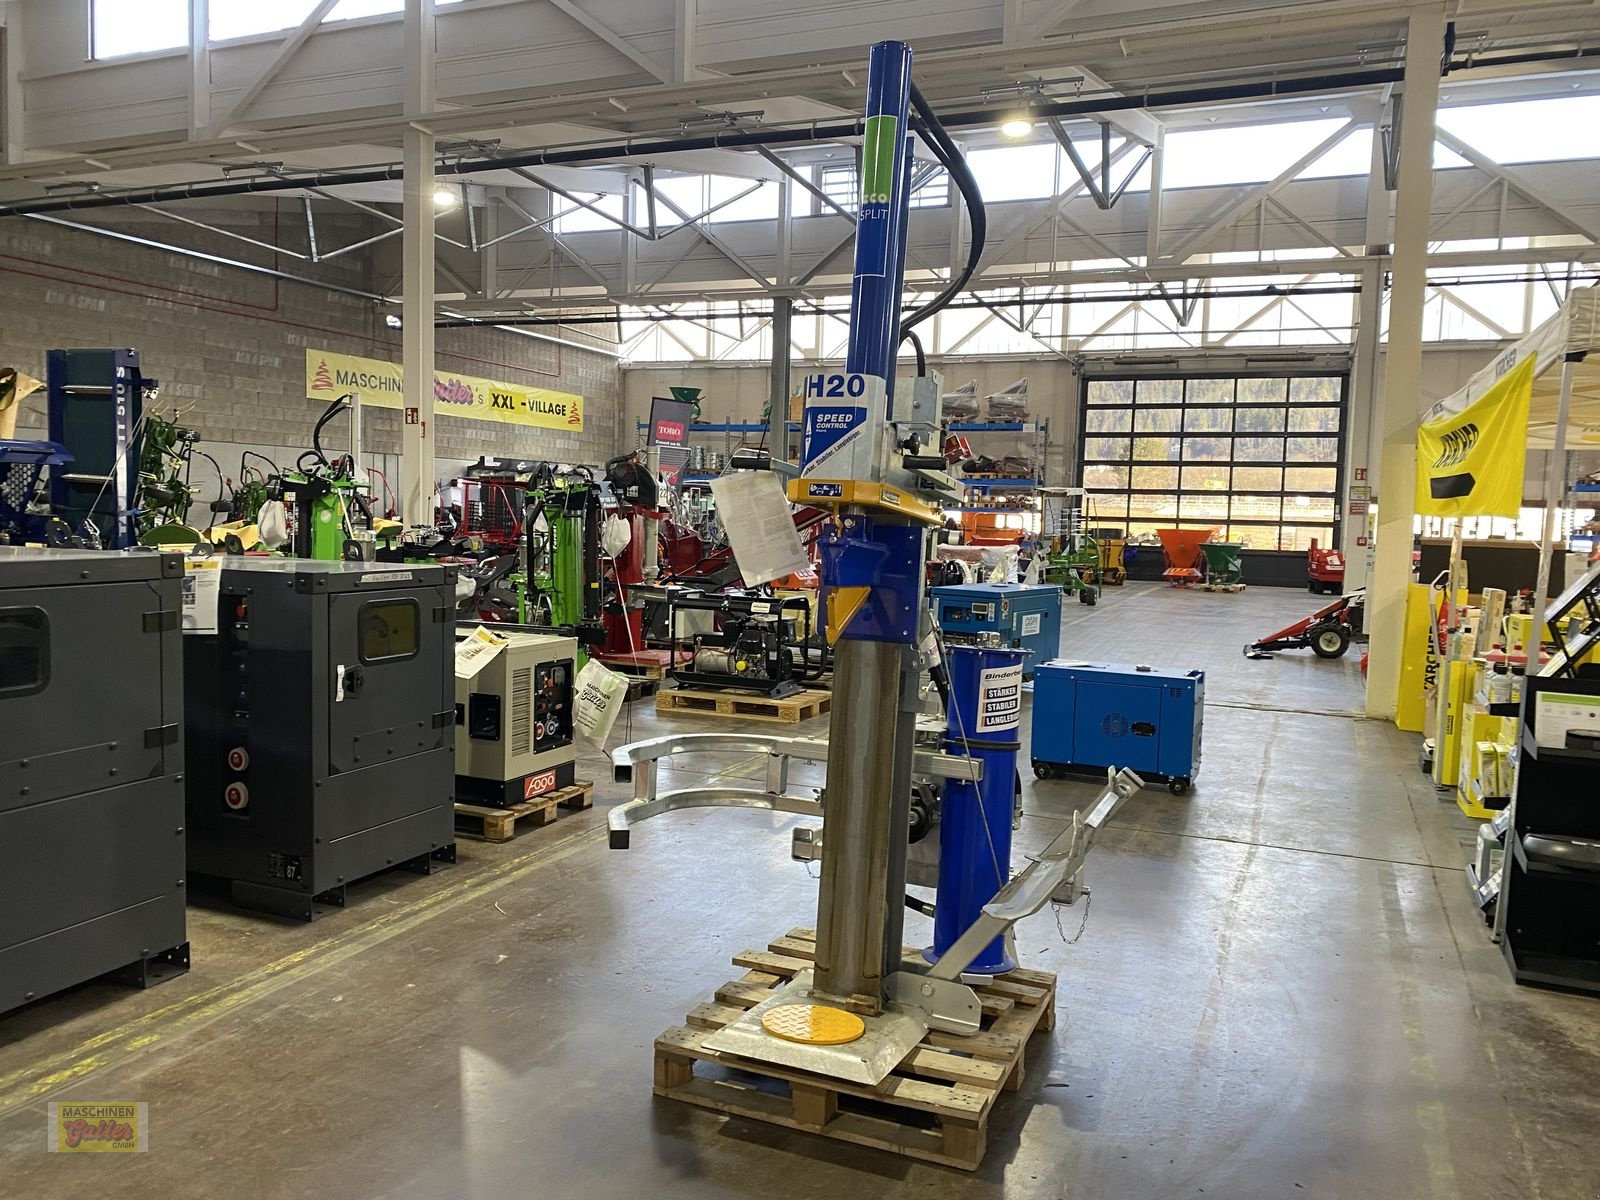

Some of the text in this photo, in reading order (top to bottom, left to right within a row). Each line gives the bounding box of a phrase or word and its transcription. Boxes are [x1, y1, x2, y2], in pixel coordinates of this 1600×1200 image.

[860, 208, 888, 221] SPLIT
[116, 366, 126, 378] S
[336, 369, 403, 393] MASCHIN
[491, 392, 515, 410] XXL
[808, 374, 865, 398] H20
[116, 383, 126, 417] 510
[816, 413, 853, 422] SPEED
[658, 426, 681, 436] TORO
[988, 686, 1016, 698] STÄRKER
[987, 700, 1016, 711] STABILER
